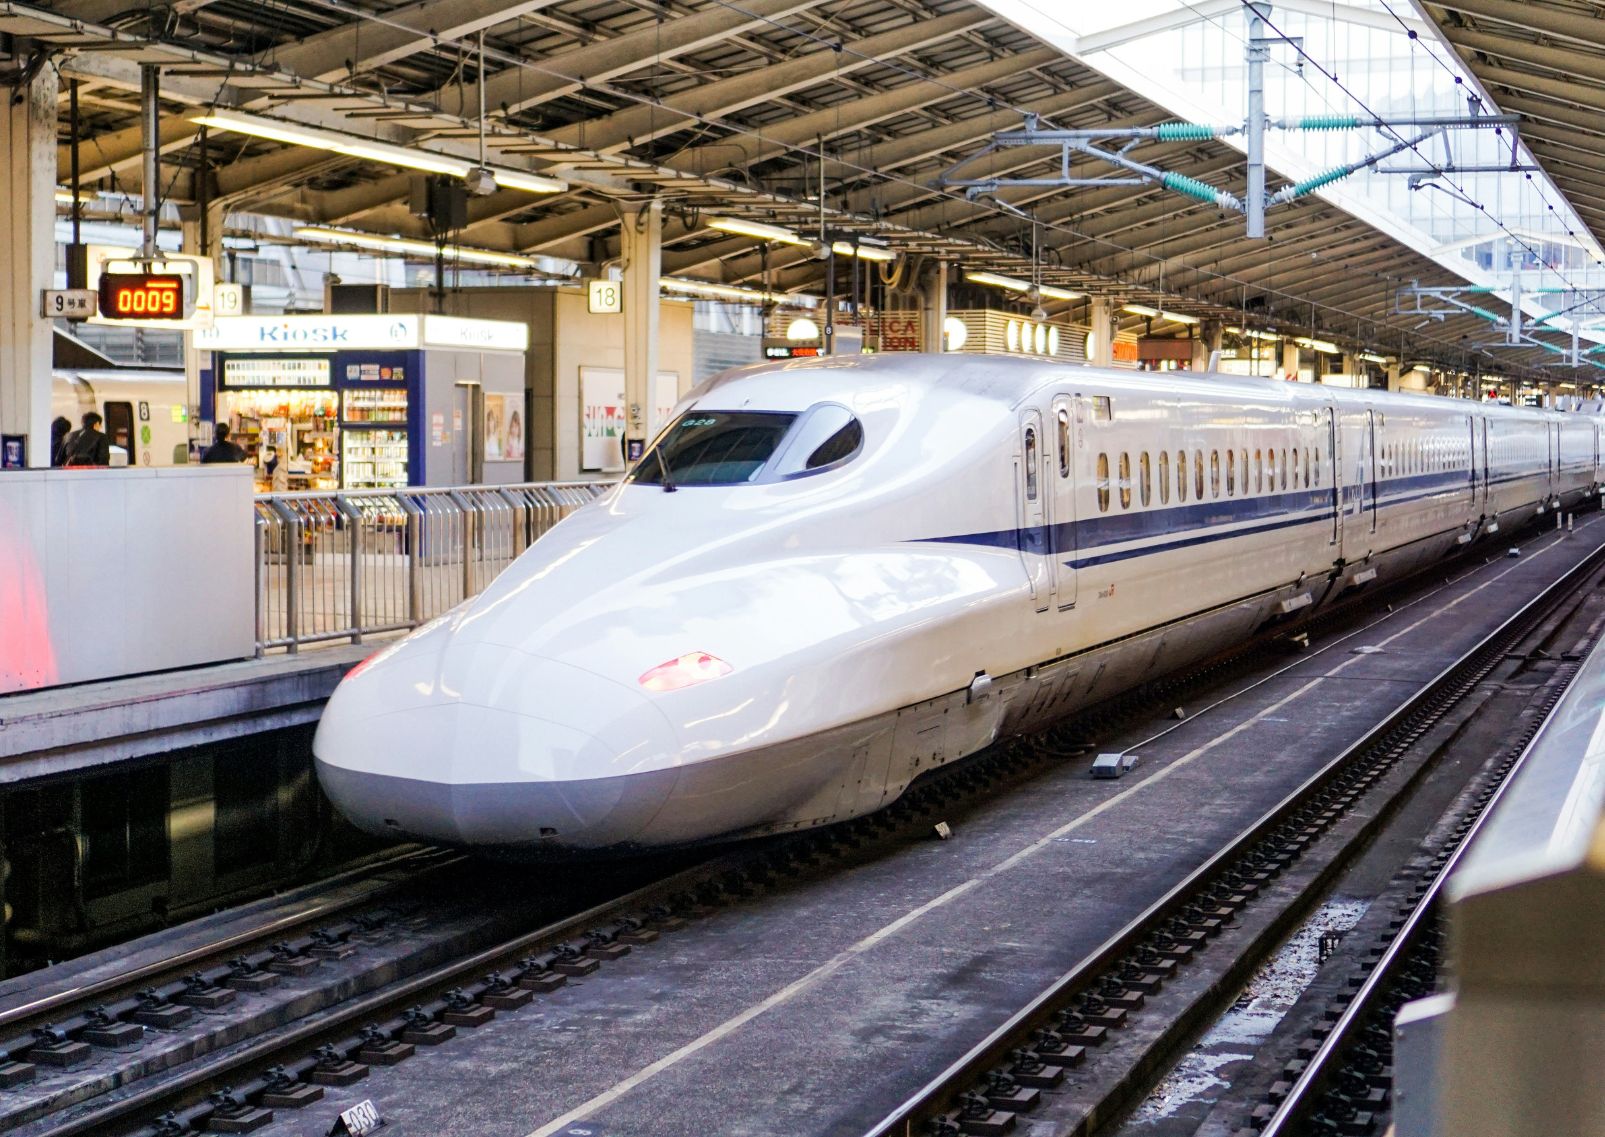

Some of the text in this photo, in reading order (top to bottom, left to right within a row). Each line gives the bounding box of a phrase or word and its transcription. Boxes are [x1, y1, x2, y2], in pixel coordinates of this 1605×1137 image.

[118, 289, 175, 313] 0009
[220, 291, 238, 311] 19
[595, 287, 616, 307] 18
[259, 323, 349, 342] Kiosk
[140, 402, 149, 420] 8
[682, 418, 716, 427] G28
